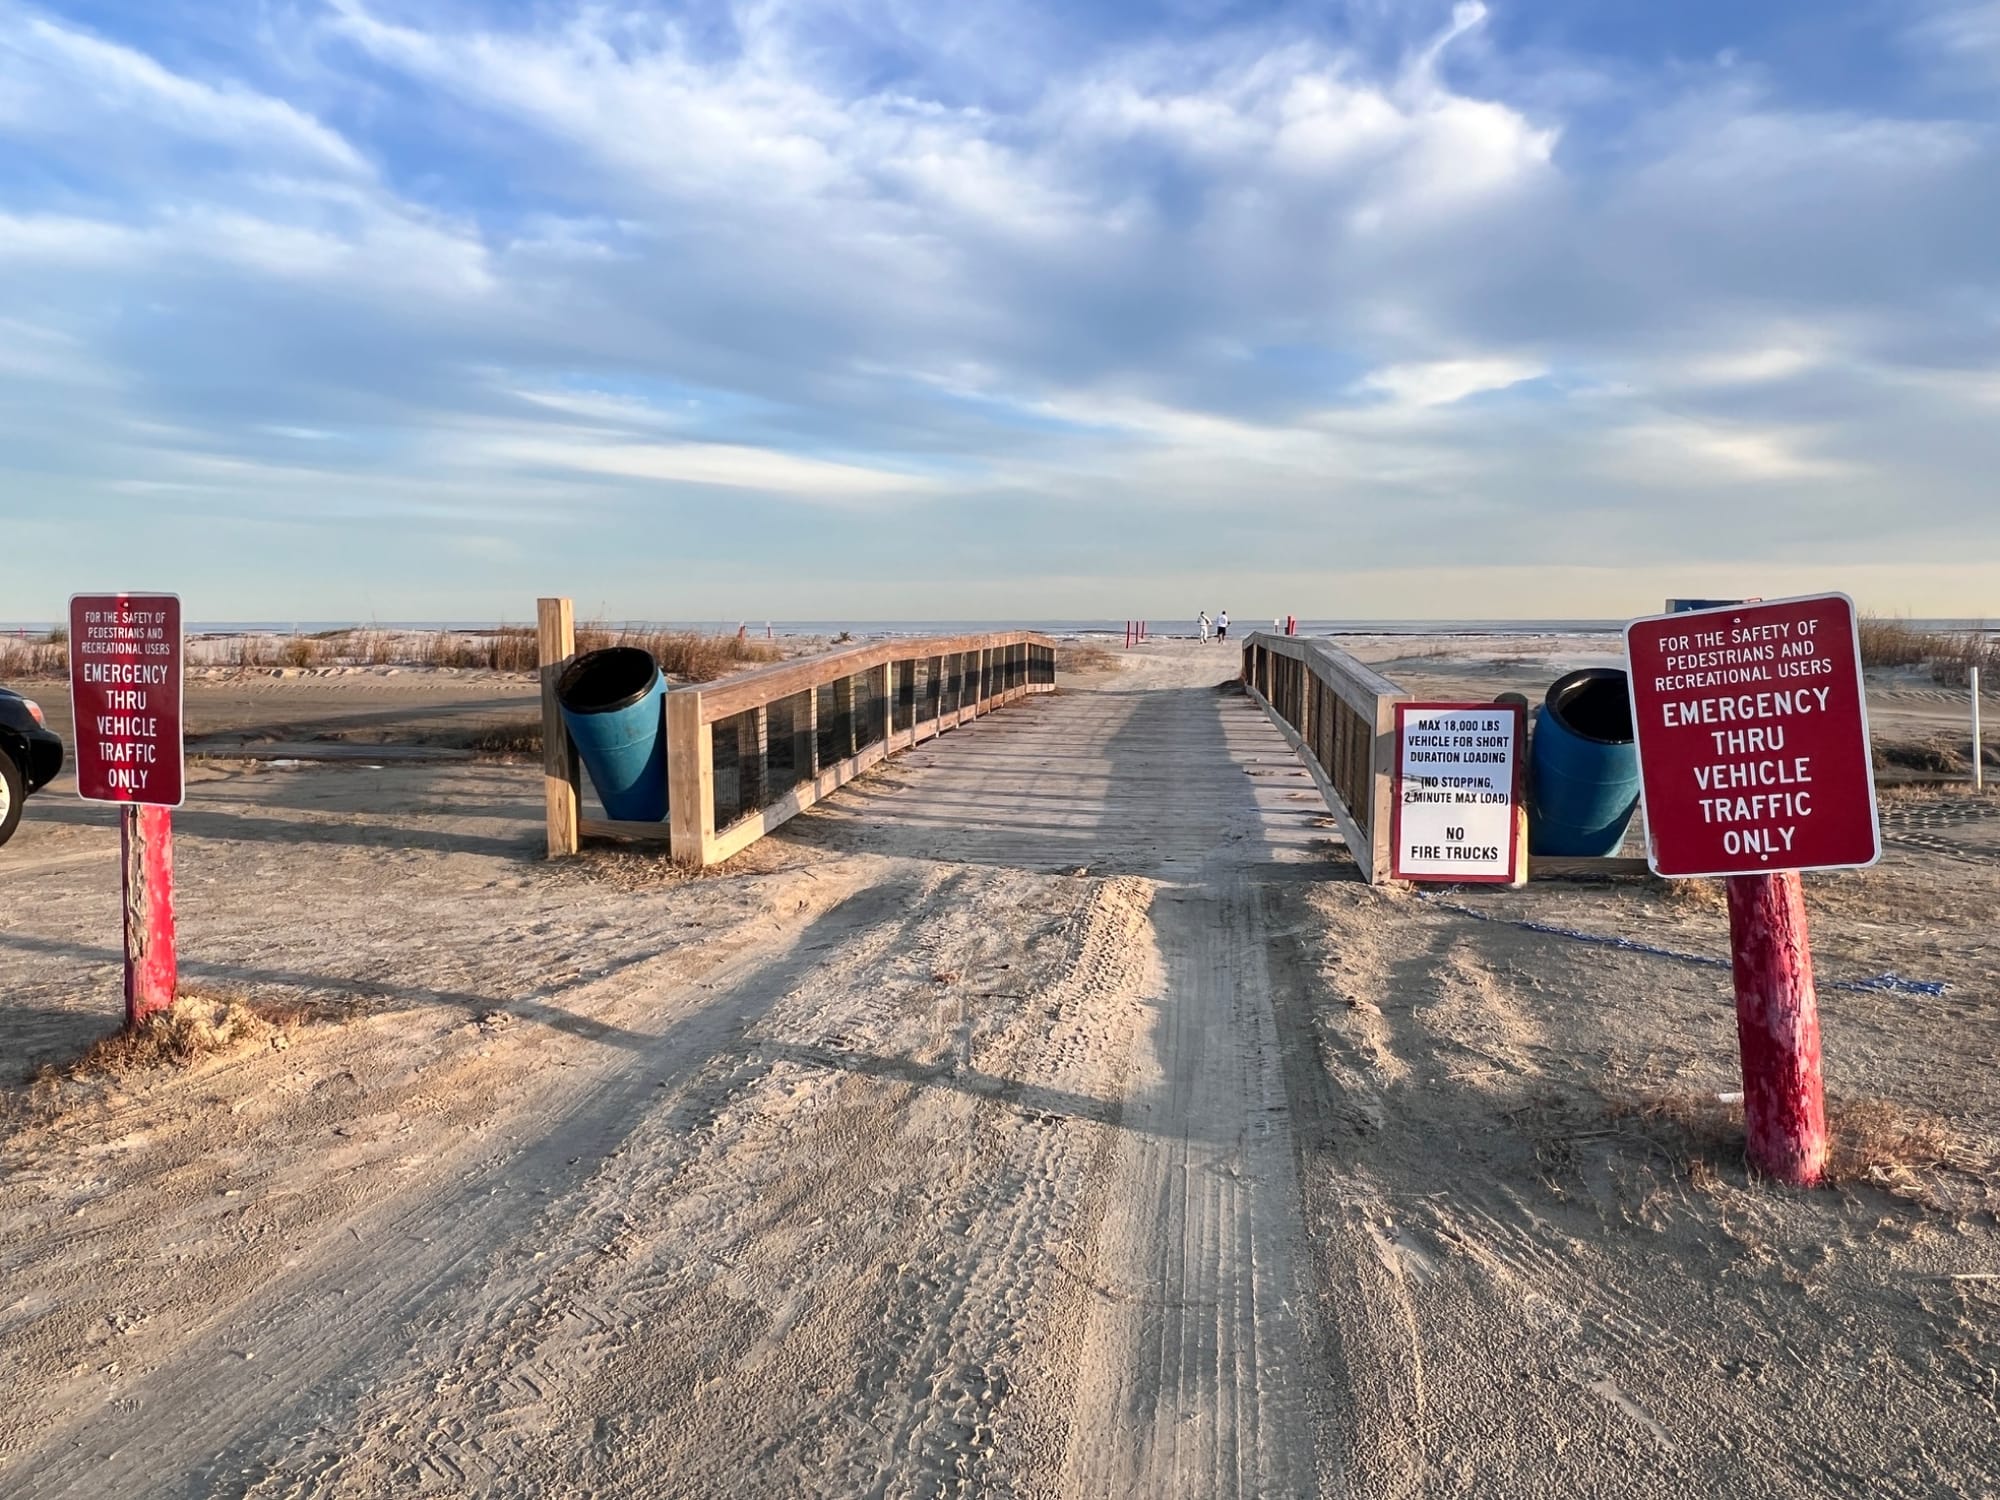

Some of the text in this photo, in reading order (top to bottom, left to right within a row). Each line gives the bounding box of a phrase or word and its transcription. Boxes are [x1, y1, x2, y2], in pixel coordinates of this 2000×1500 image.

[85, 612, 165, 623] FOR THE SAFETY OF
[88, 627, 162, 638] PEDESTRIANS AND
[1659, 620, 1818, 653] FOR THE SAFETY OF
[81, 643, 170, 654] RECREATIONAL USERS
[1667, 641, 1814, 671] PEDESTRIANS AND
[84, 664, 168, 684] EMERGENCY
[1655, 658, 1832, 691] RECREATIONAL USERS
[106, 690, 146, 710] THRU
[1662, 686, 1830, 727] EMERGENCY
[97, 716, 157, 737] VEHICLE
[1419, 720, 1499, 732] MAX 18,000 LBS
[1408, 736, 1509, 747] VEHICLE FOR SHORT
[1711, 726, 1784, 755] THRU
[99, 742, 156, 763] TRAFFIC
[1410, 752, 1506, 763] DURATION LOADING
[109, 769, 148, 788] ONLY
[1421, 776, 1493, 789] (NO STOPPING,
[1693, 757, 1812, 790] VEHICLE
[1456, 792, 1476, 804] MAX
[1481, 792, 1509, 806] LOAD)
[1699, 792, 1812, 823] TRAFFIC
[1446, 827, 1464, 840] NO
[1724, 827, 1796, 855] ONLY
[1411, 847, 1498, 860] FIRE TRUCKS
